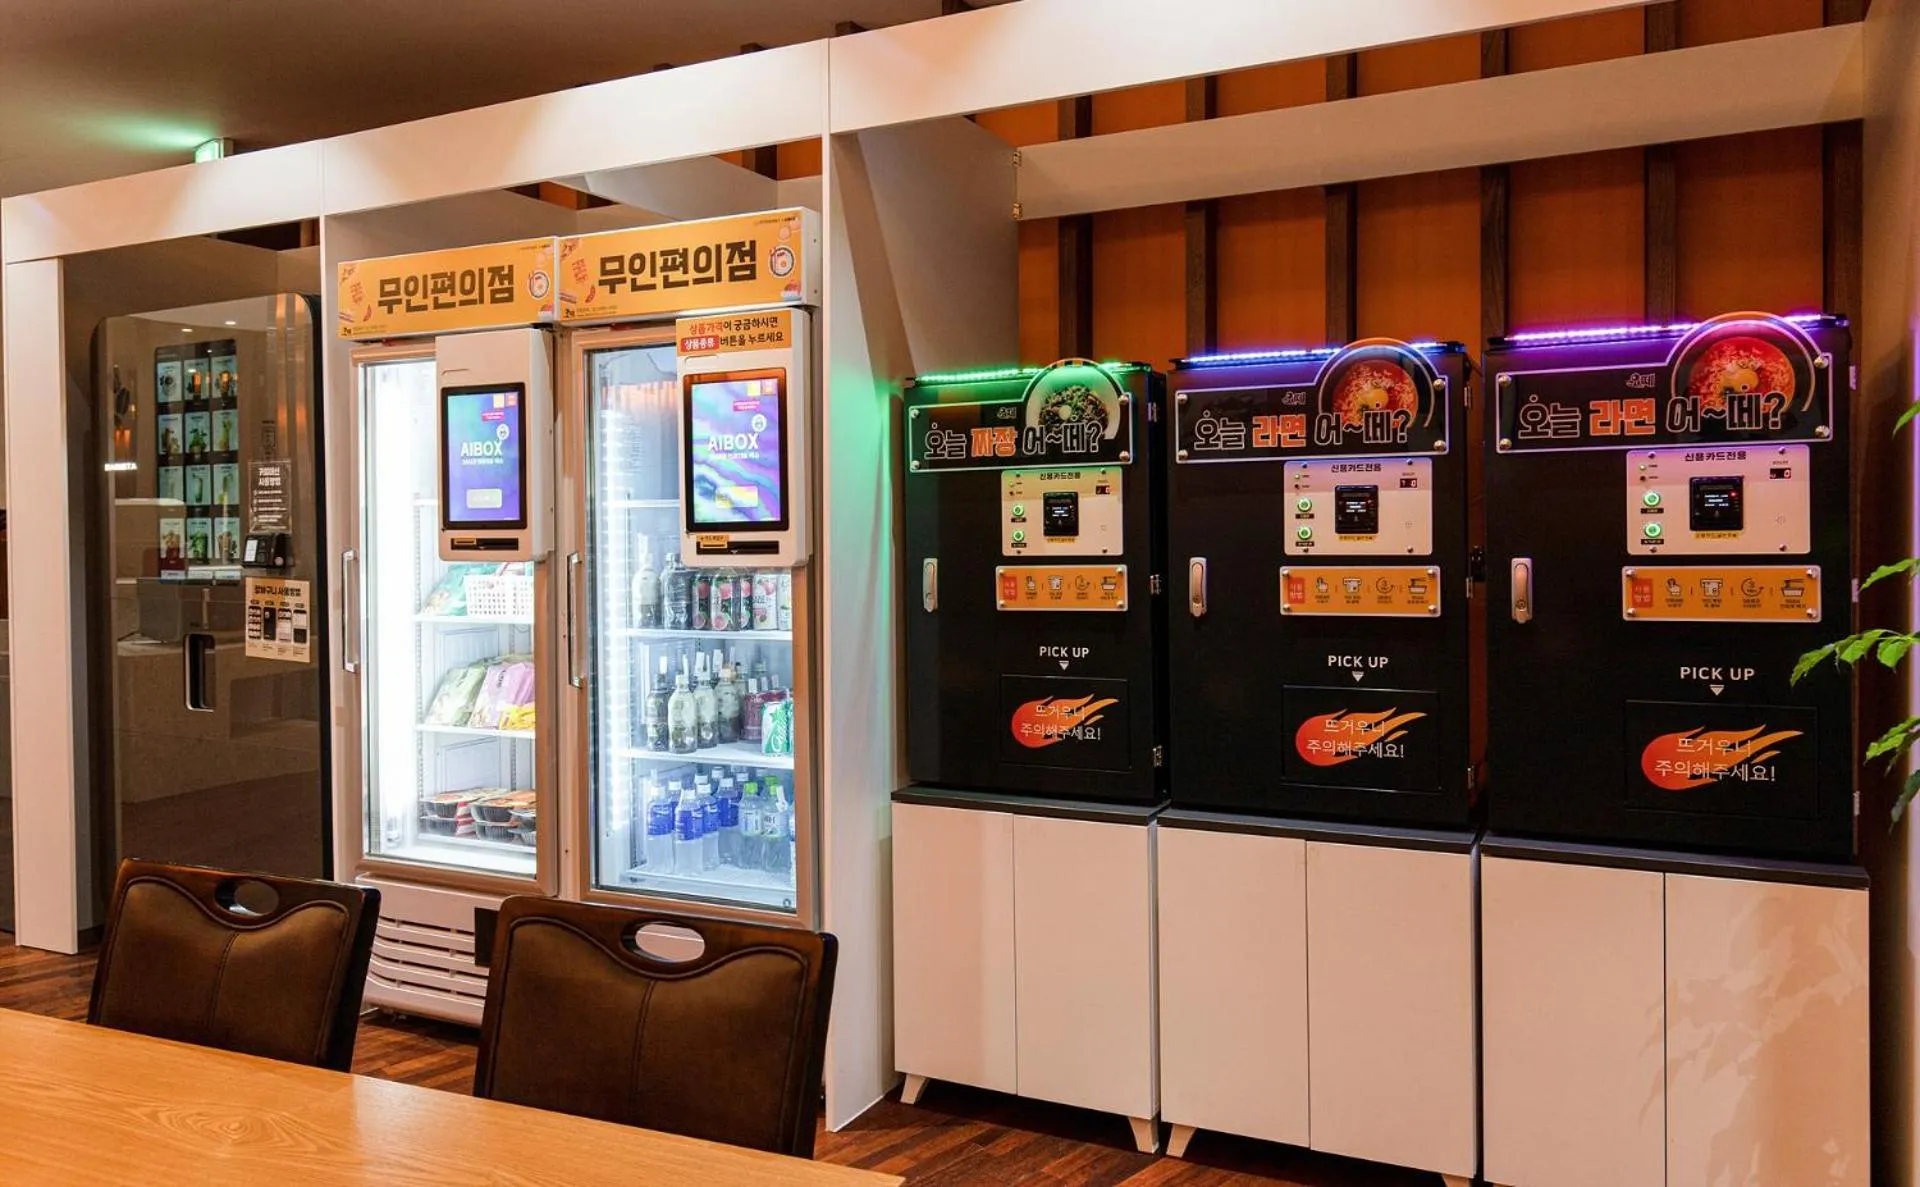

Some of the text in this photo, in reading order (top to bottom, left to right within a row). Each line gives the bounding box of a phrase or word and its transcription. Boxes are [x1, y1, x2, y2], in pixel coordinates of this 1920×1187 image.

[598, 240, 757, 294] 무인편의점
[378, 265, 514, 314] 무인편의점
[689, 317, 778, 336] 상품가격이 궁금하시면
[720, 335, 746, 347] 버튼을
[748, 332, 784, 344] 누르세요
[1518, 394, 1582, 440] 오늘
[1589, 398, 1656, 436] 라면
[1194, 410, 1246, 451] 오늘
[1252, 413, 1307, 449] 라면
[461, 441, 503, 457] AIBOX
[708, 432, 760, 451] AIBOX
[924, 422, 967, 460] 오늘
[970, 425, 1018, 457] 짜장
[1685, 450, 1747, 462] 신용카드전용
[1331, 463, 1382, 473] 신용카드전용
[1040, 646, 1090, 658] PICK UP
[1328, 655, 1389, 668] PICK UP
[1680, 666, 1755, 681] PICK UP
[1035, 704, 1085, 720] 뜨거우니
[1020, 722, 1101, 741] 주의해주세요!
[1324, 719, 1385, 736] 뜨거우니
[1306, 739, 1404, 758] 주의해주세요!
[1677, 738, 1751, 757] 뜨거우니
[1655, 760, 1776, 782] 주의해주세요!
